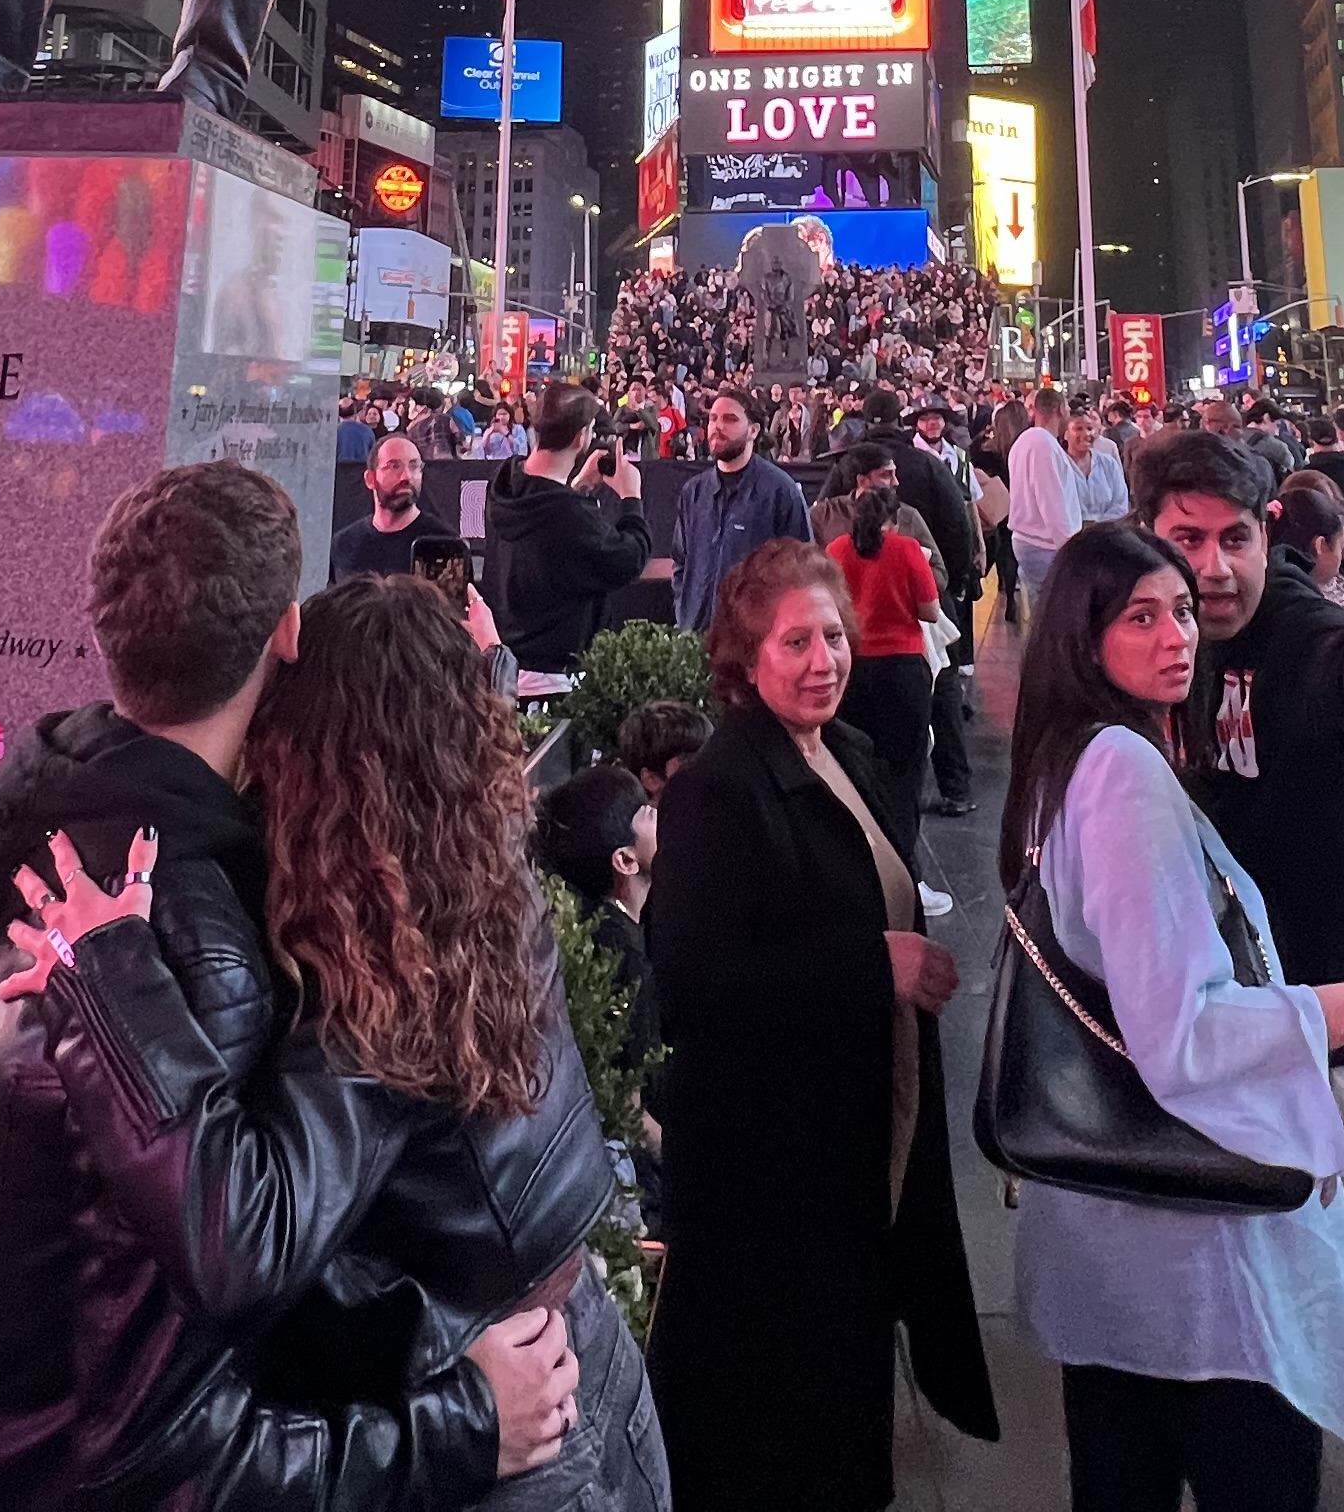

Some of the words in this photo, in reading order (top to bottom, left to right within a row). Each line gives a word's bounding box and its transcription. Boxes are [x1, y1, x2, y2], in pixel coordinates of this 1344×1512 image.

[463, 67, 494, 79] Clear
[495, 69, 541, 81] Cannel
[479, 79, 523, 91] Outor
[689, 68, 752, 93] ONE
[763, 64, 865, 90] NIGHT
[876, 62, 914, 86] IN
[725, 94, 878, 143] LOVE
[1122, 318, 1155, 383] tkts
